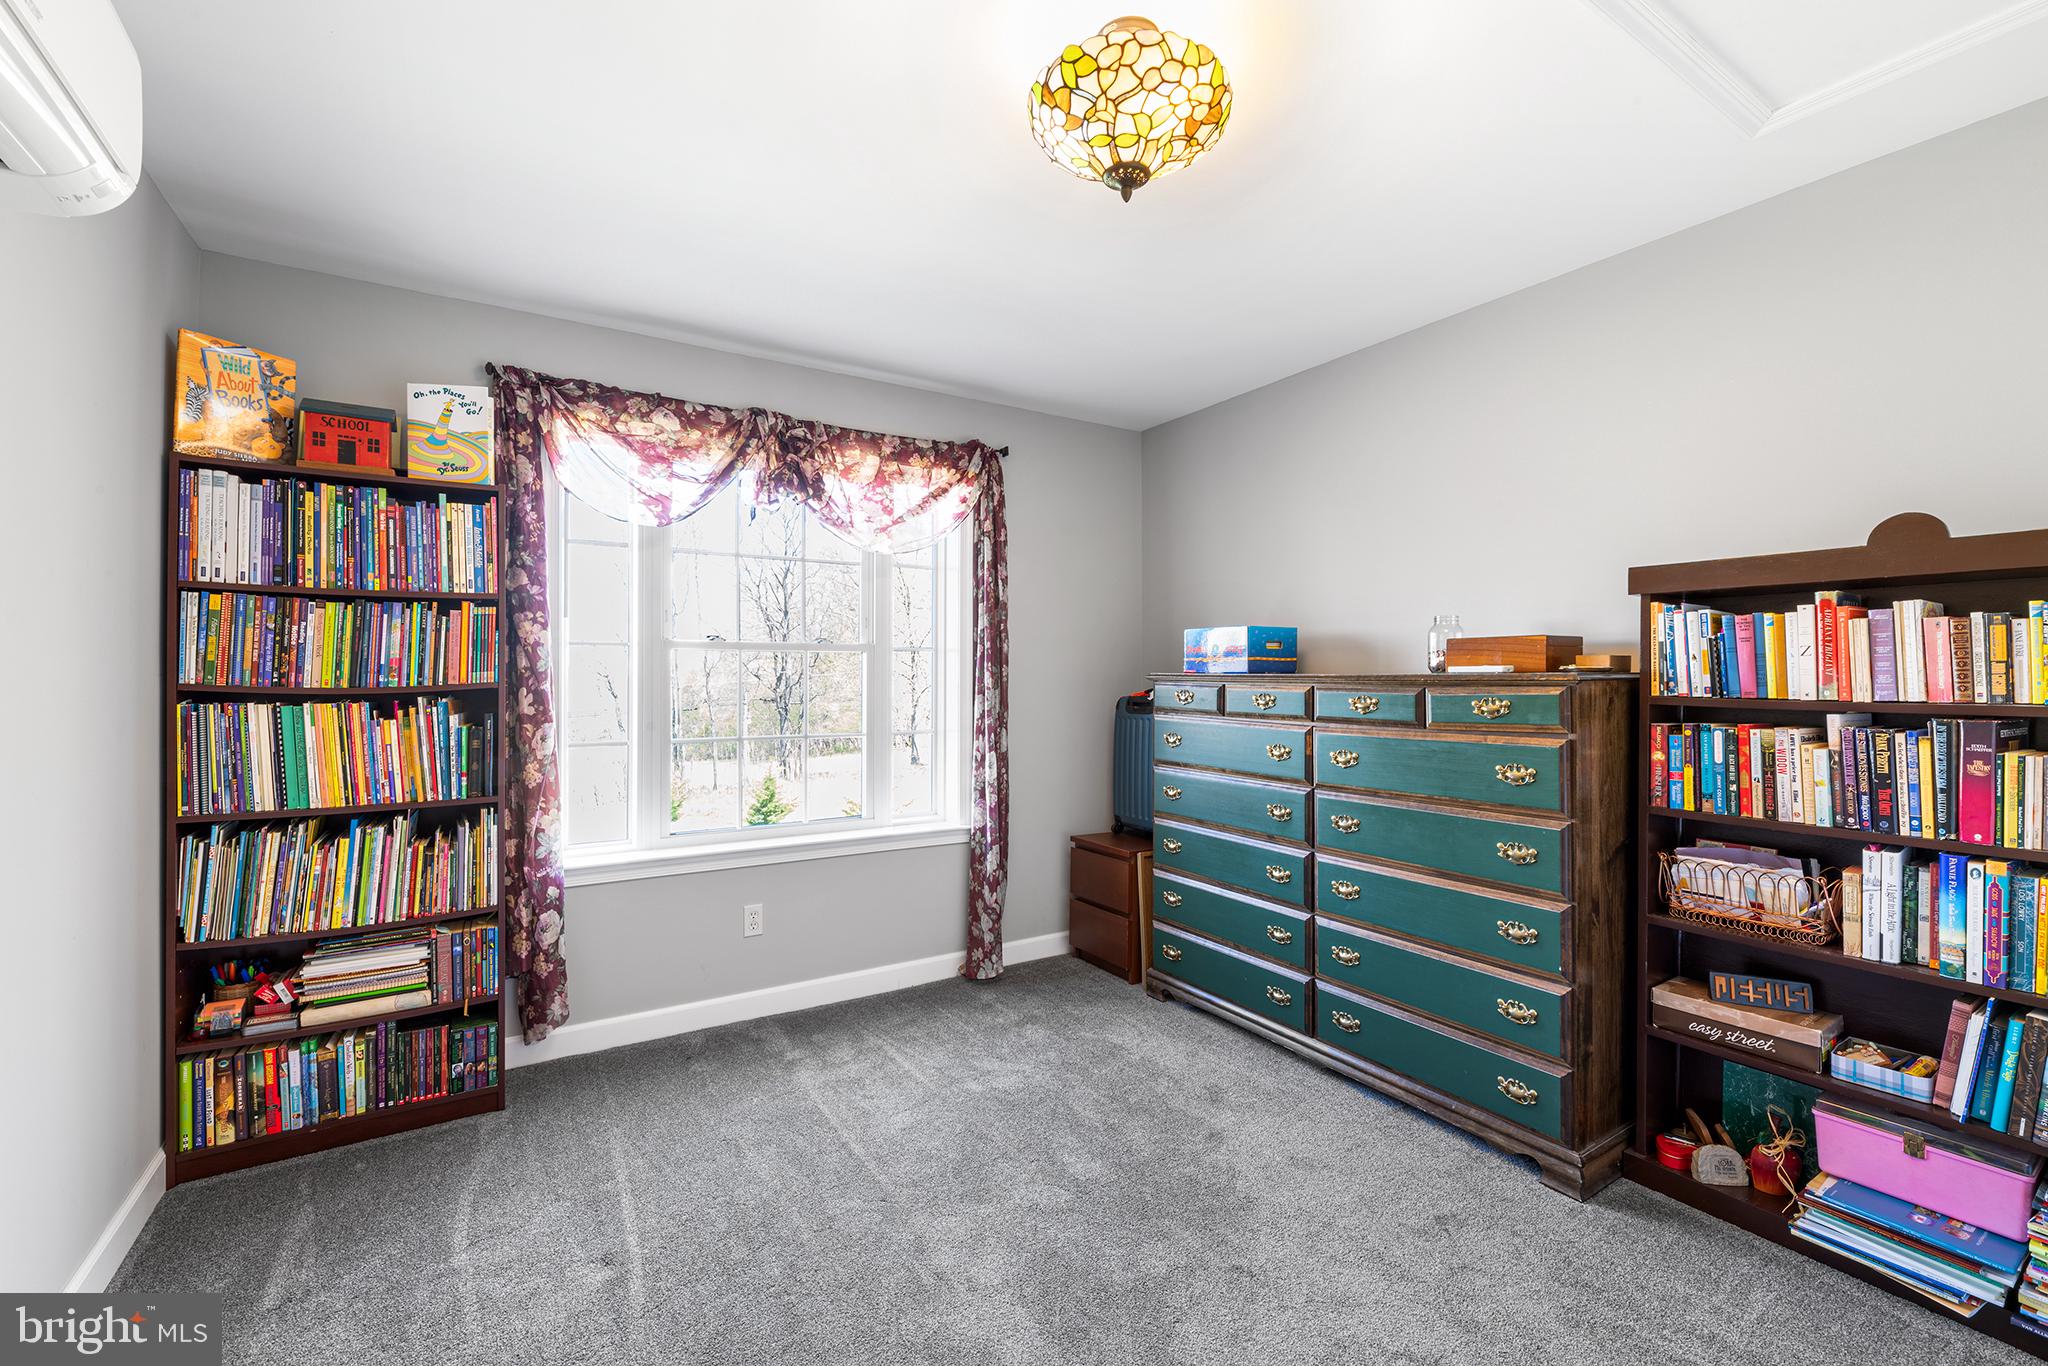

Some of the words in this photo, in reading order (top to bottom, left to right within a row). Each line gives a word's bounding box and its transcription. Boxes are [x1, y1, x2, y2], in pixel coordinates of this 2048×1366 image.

[218, 354, 251, 376] Wild
[217, 371, 258, 393] About
[216, 390, 263, 411] Books
[443, 388, 465, 400] Places
[466, 406, 483, 415] Go!
[320, 416, 372, 432] SCHOOL
[437, 467, 450, 475] Dr.
[450, 463, 469, 472] Seuss
[1824, 608, 1833, 640] ADRIANA
[1825, 642, 1833, 676] TRIGIANI
[1875, 733, 1890, 750] FRANK
[1777, 748, 1788, 775] WIDOW
[1876, 751, 1891, 774] PERETTI
[1858, 773, 1868, 792] STONES
[1878, 789, 1892, 800] THE
[1879, 801, 1892, 816] OATH
[1948, 857, 1957, 880] FANNIE
[1885, 888, 1896, 902] Light
[1949, 881, 1957, 900] FLAGG
[2018, 889, 2026, 901] LOIS
[1887, 910, 1896, 918] the
[1887, 919, 1897, 933] Attic
[1689, 1022, 1723, 1040] easy
[1725, 1030, 1776, 1053] street.
